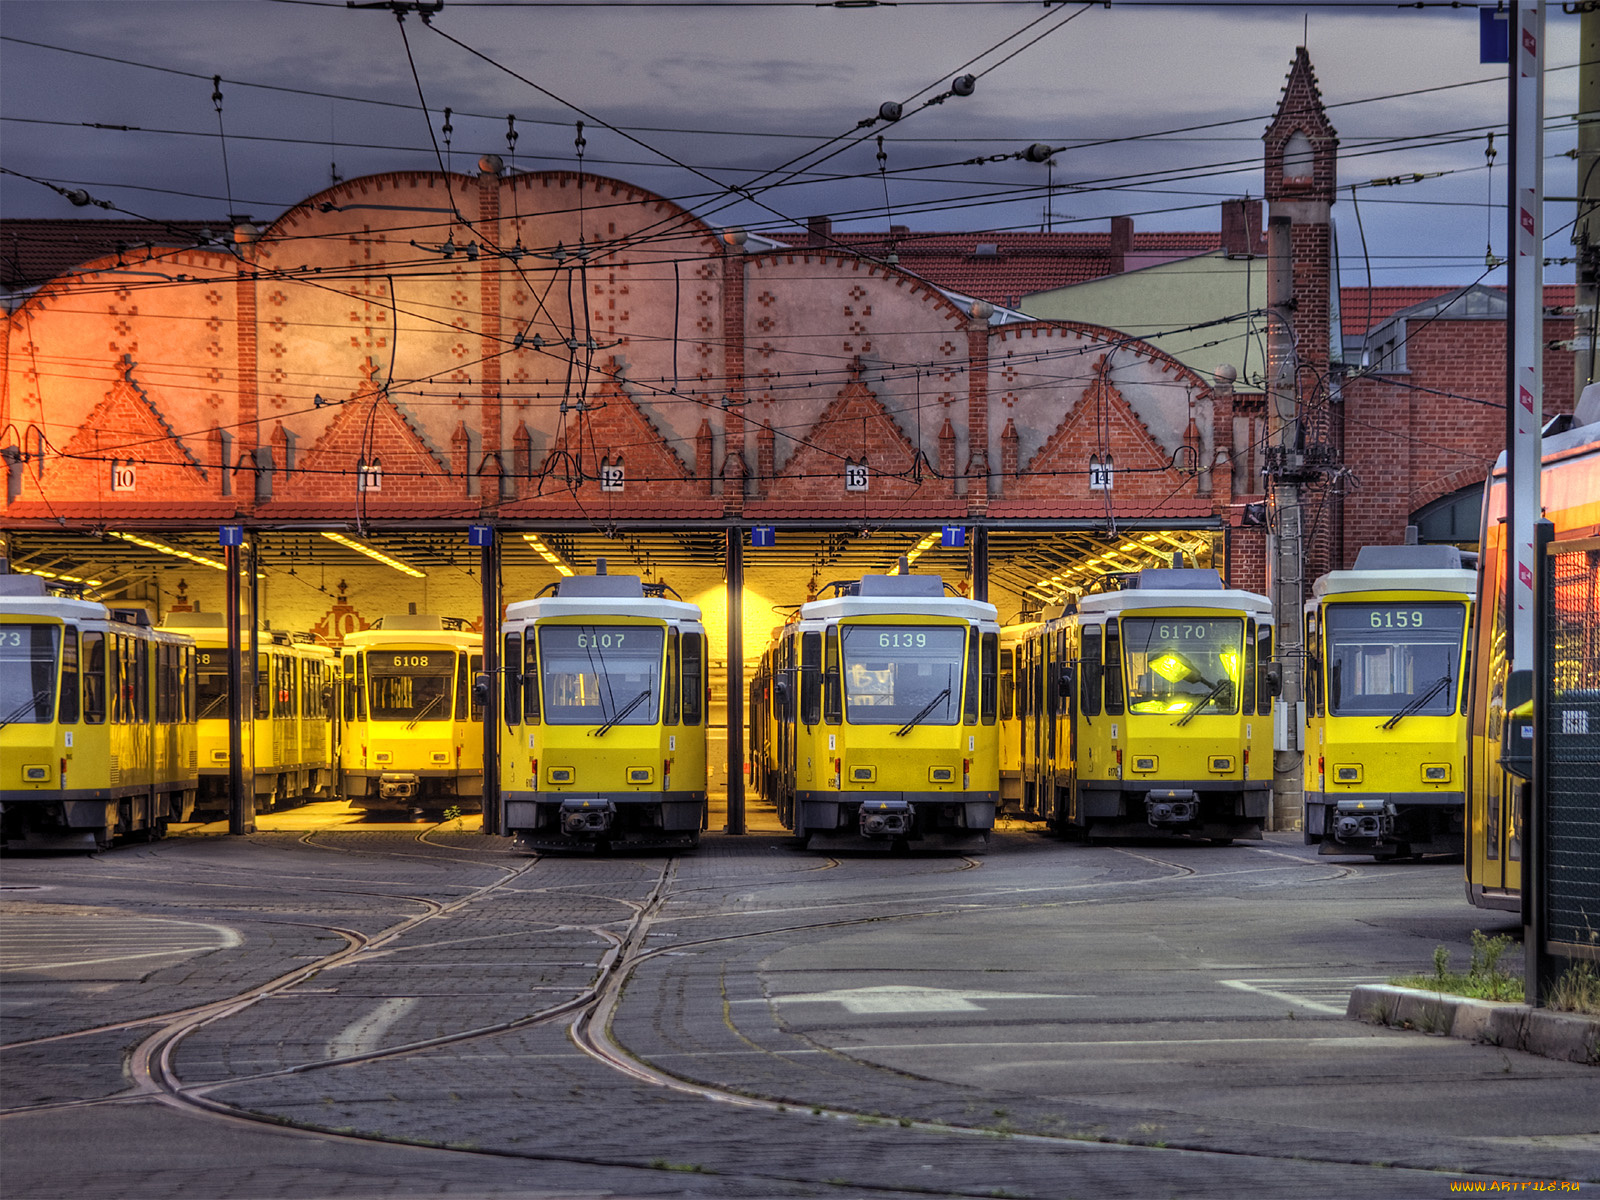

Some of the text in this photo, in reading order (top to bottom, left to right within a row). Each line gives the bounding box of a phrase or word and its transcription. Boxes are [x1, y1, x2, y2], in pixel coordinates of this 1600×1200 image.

[115, 470, 134, 488] 10
[362, 470, 380, 488] 11
[605, 470, 624, 488] 12
[848, 469, 867, 487] 13
[1092, 469, 1111, 486] 14
[224, 527, 239, 545] T
[473, 527, 488, 545] T
[755, 528, 770, 545] T
[946, 528, 961, 545] T
[320, 612, 361, 640] 10
[1370, 611, 1423, 628] 6159
[879, 633, 926, 648] 6139
[1159, 625, 1206, 639] 6170
[577, 633, 625, 649] 6107
[393, 655, 429, 668] 6108
